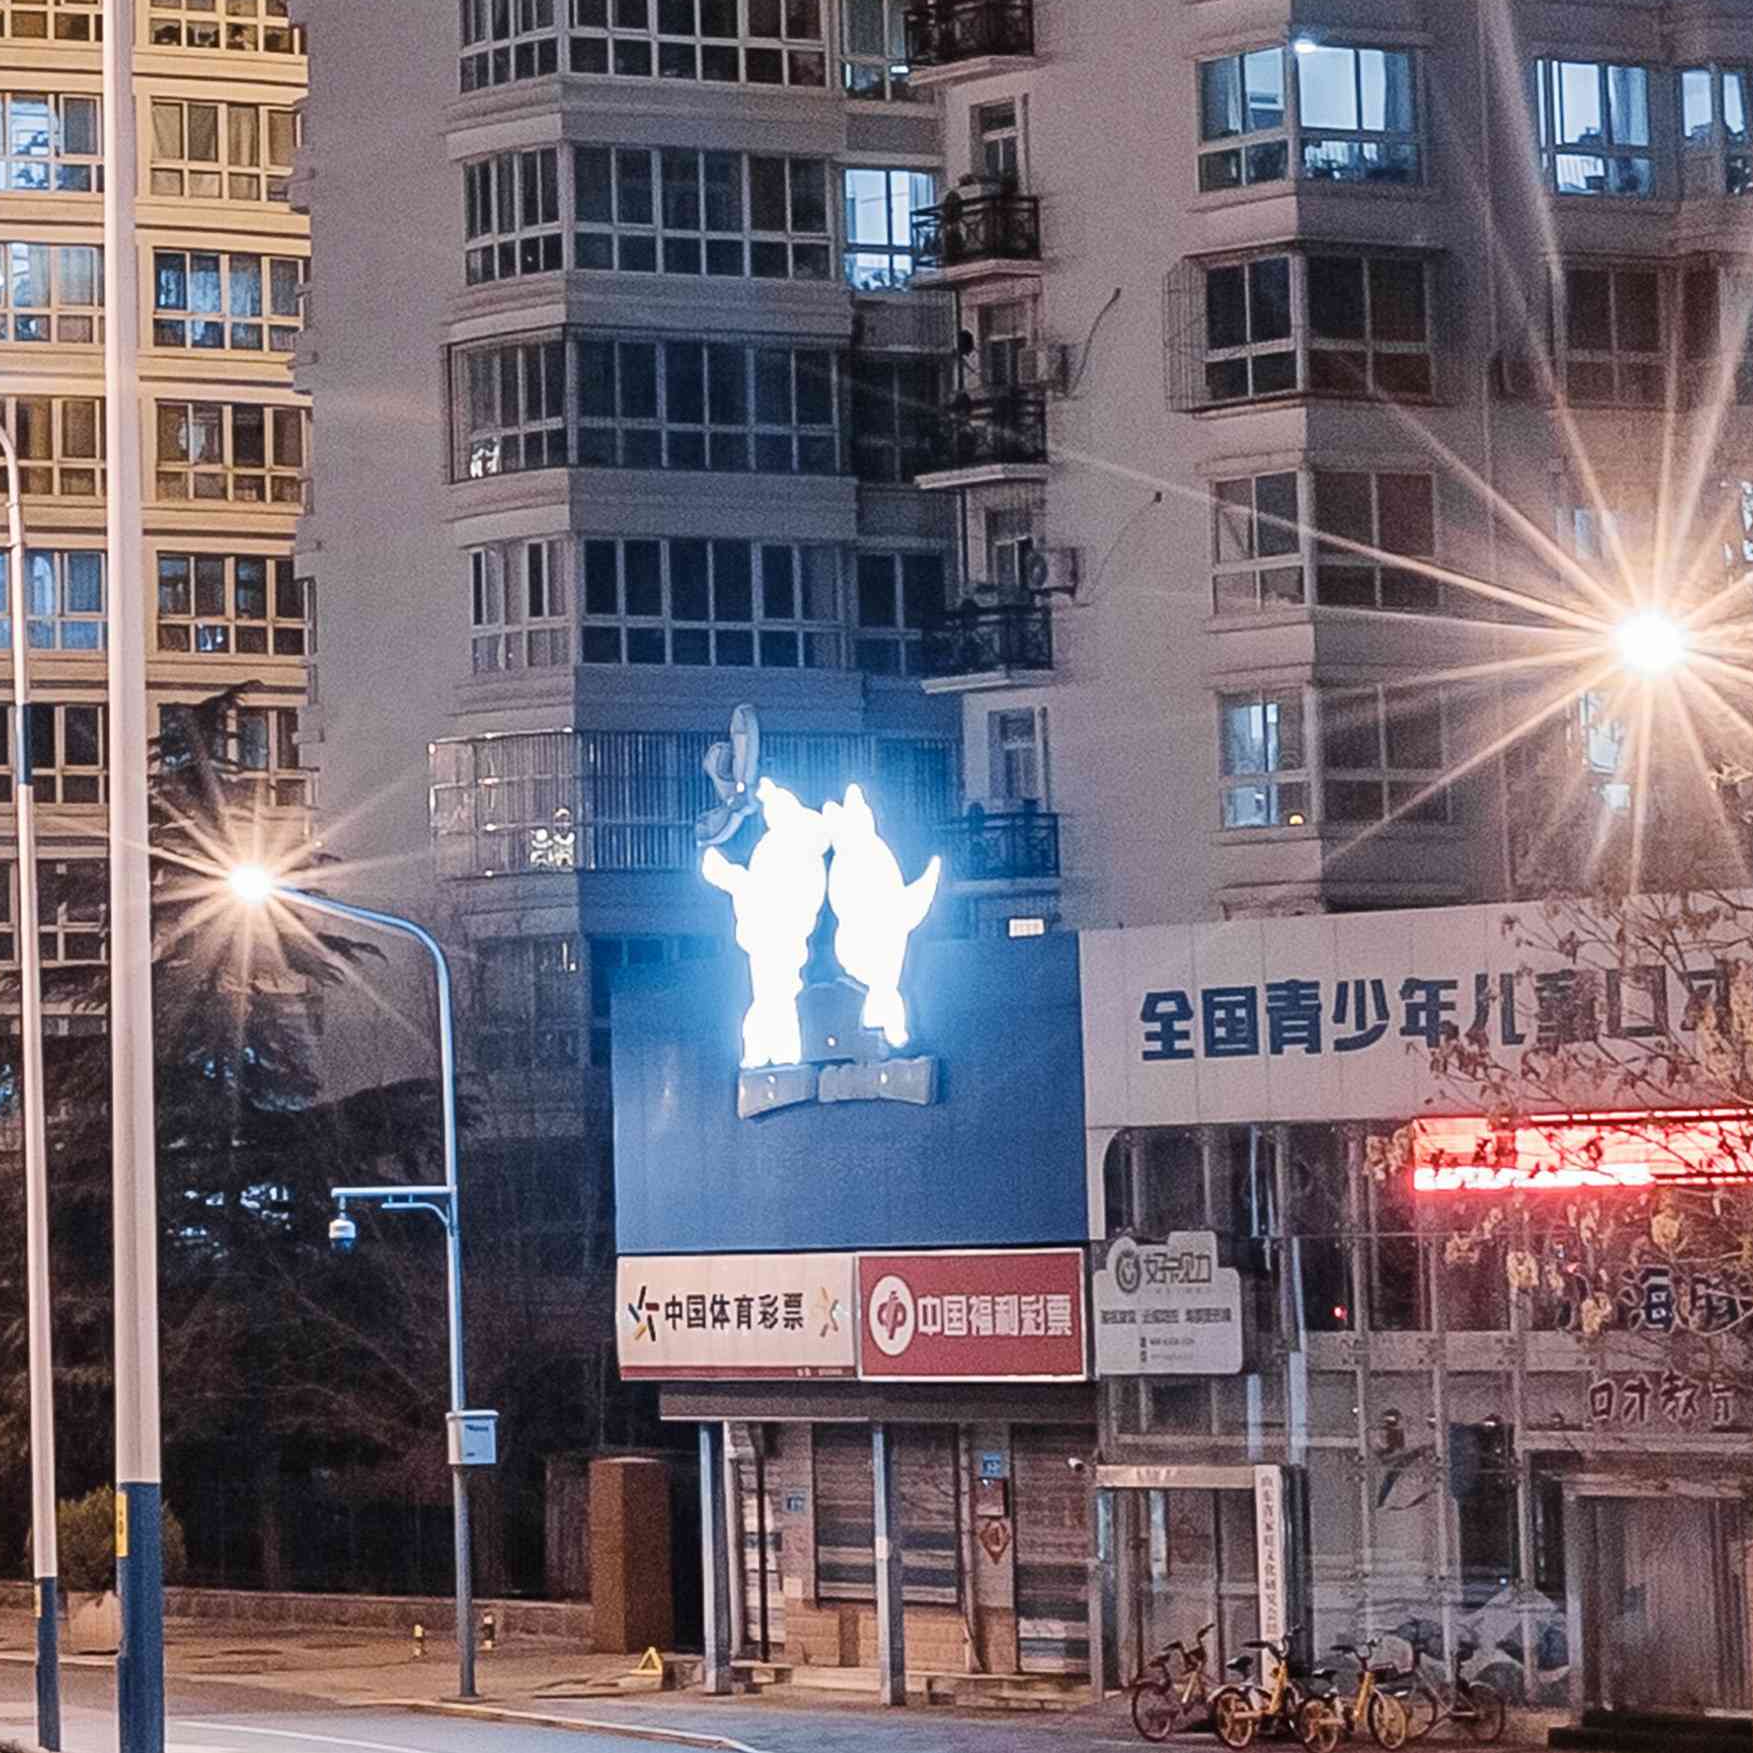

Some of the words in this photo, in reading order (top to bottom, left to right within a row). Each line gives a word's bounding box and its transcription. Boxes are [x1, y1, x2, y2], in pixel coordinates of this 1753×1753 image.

[664, 1292, 804, 1332] 中国体育彩票
[917, 1293, 1074, 1338] 中国福利彩票
